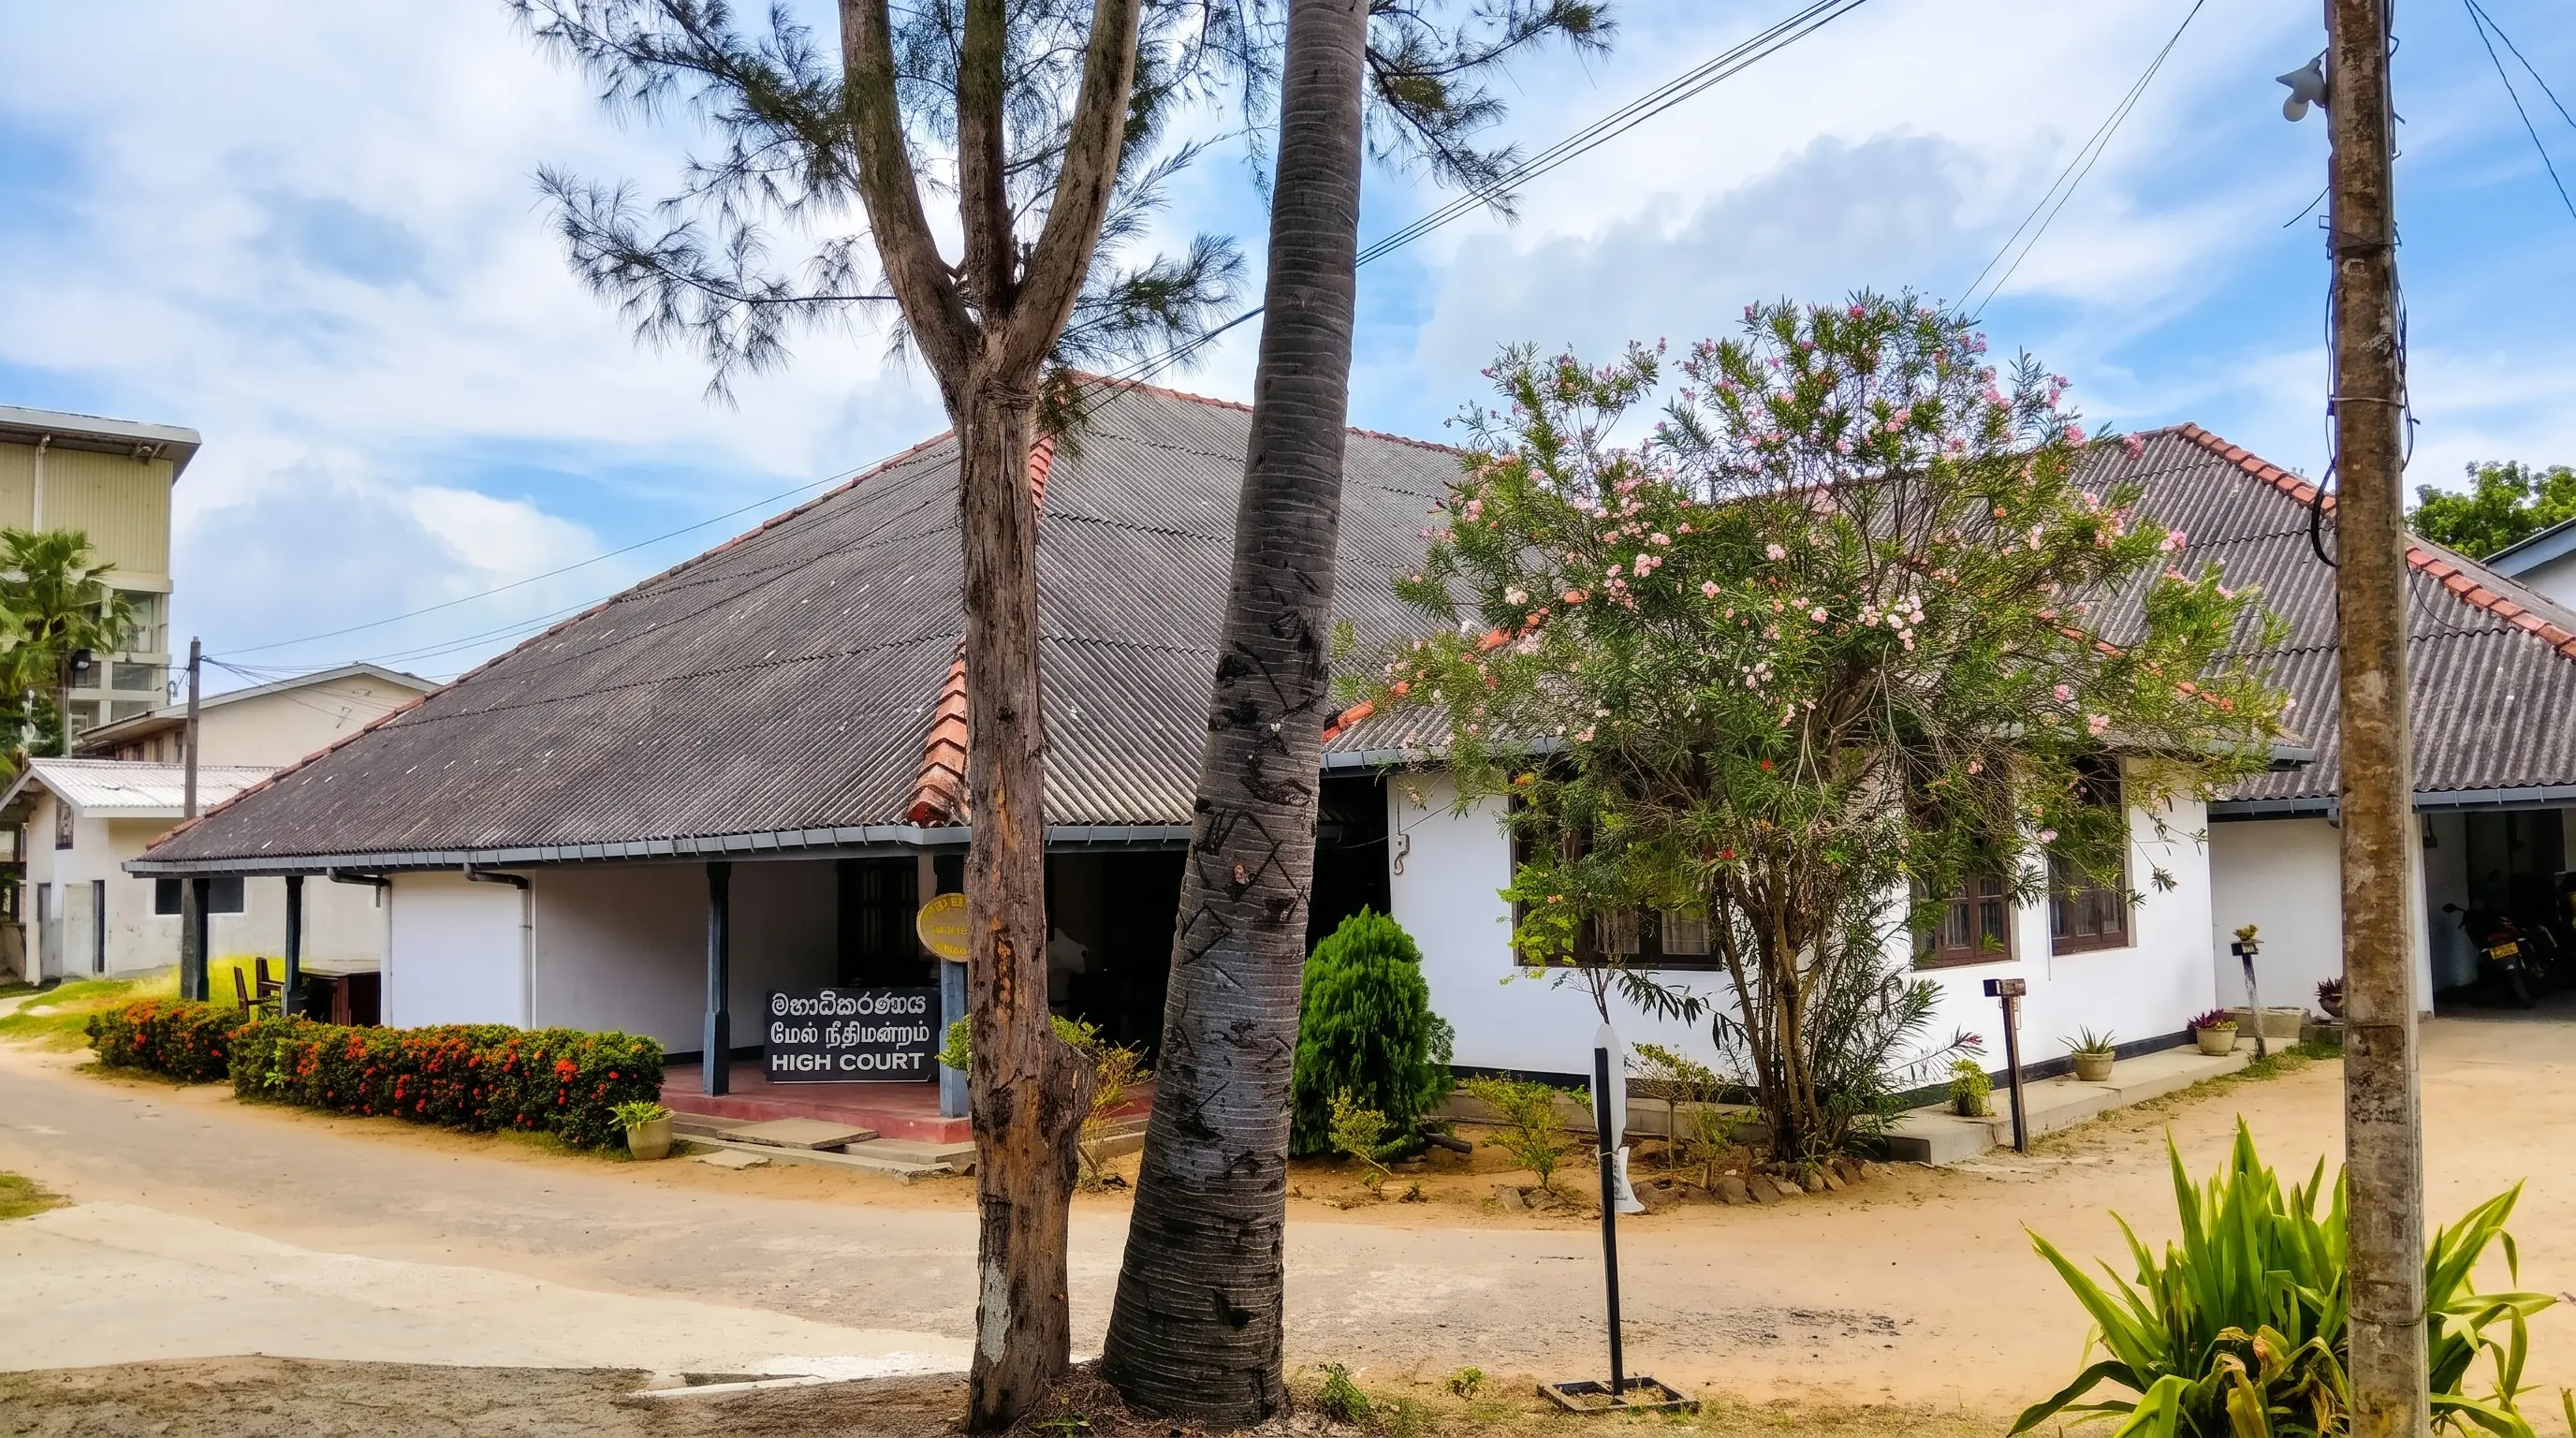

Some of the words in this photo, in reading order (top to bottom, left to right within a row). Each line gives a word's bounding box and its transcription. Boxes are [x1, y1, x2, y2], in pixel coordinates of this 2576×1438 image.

[770, 1020, 818, 1044] மேல்
[826, 1020, 929, 1049] நீதிமன்றம்
[772, 1054, 831, 1071] HIGH
[840, 1052, 925, 1071] COURT
